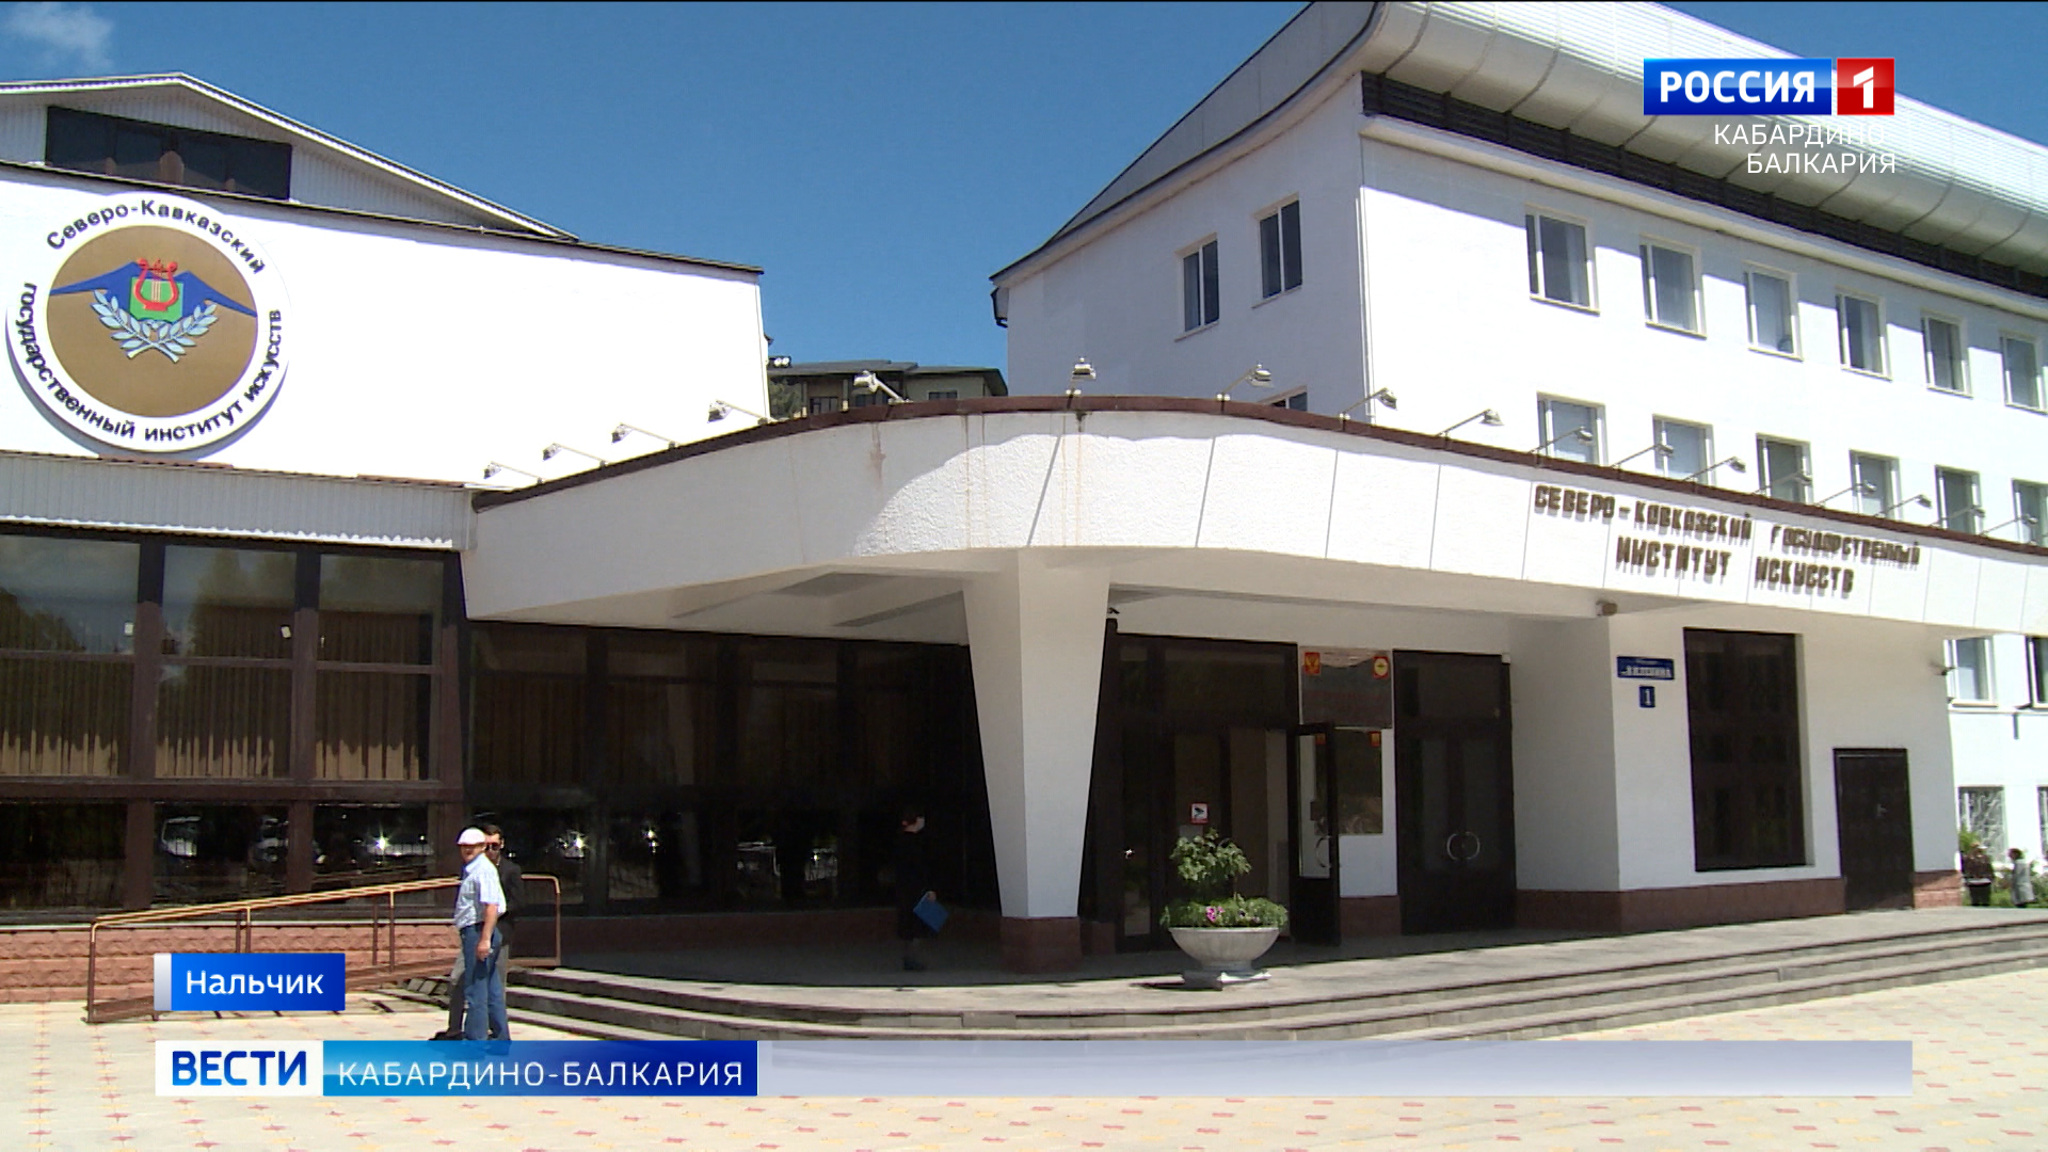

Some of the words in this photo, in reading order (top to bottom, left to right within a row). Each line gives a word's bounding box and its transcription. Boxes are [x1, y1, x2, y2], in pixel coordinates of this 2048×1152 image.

[47, 199, 266, 274] Северо-Кавказский
[15, 282, 135, 438] государственный
[144, 400, 243, 442] институт
[244, 309, 282, 402] искусств
[1615, 535, 1732, 577] ИНСТИТУТ
[1754, 556, 1855, 593] ИСКУССТВ
[1770, 524, 1920, 566] ГОСУДАРСТВЕННЫЙ
[1644, 688, 1652, 706] 1
